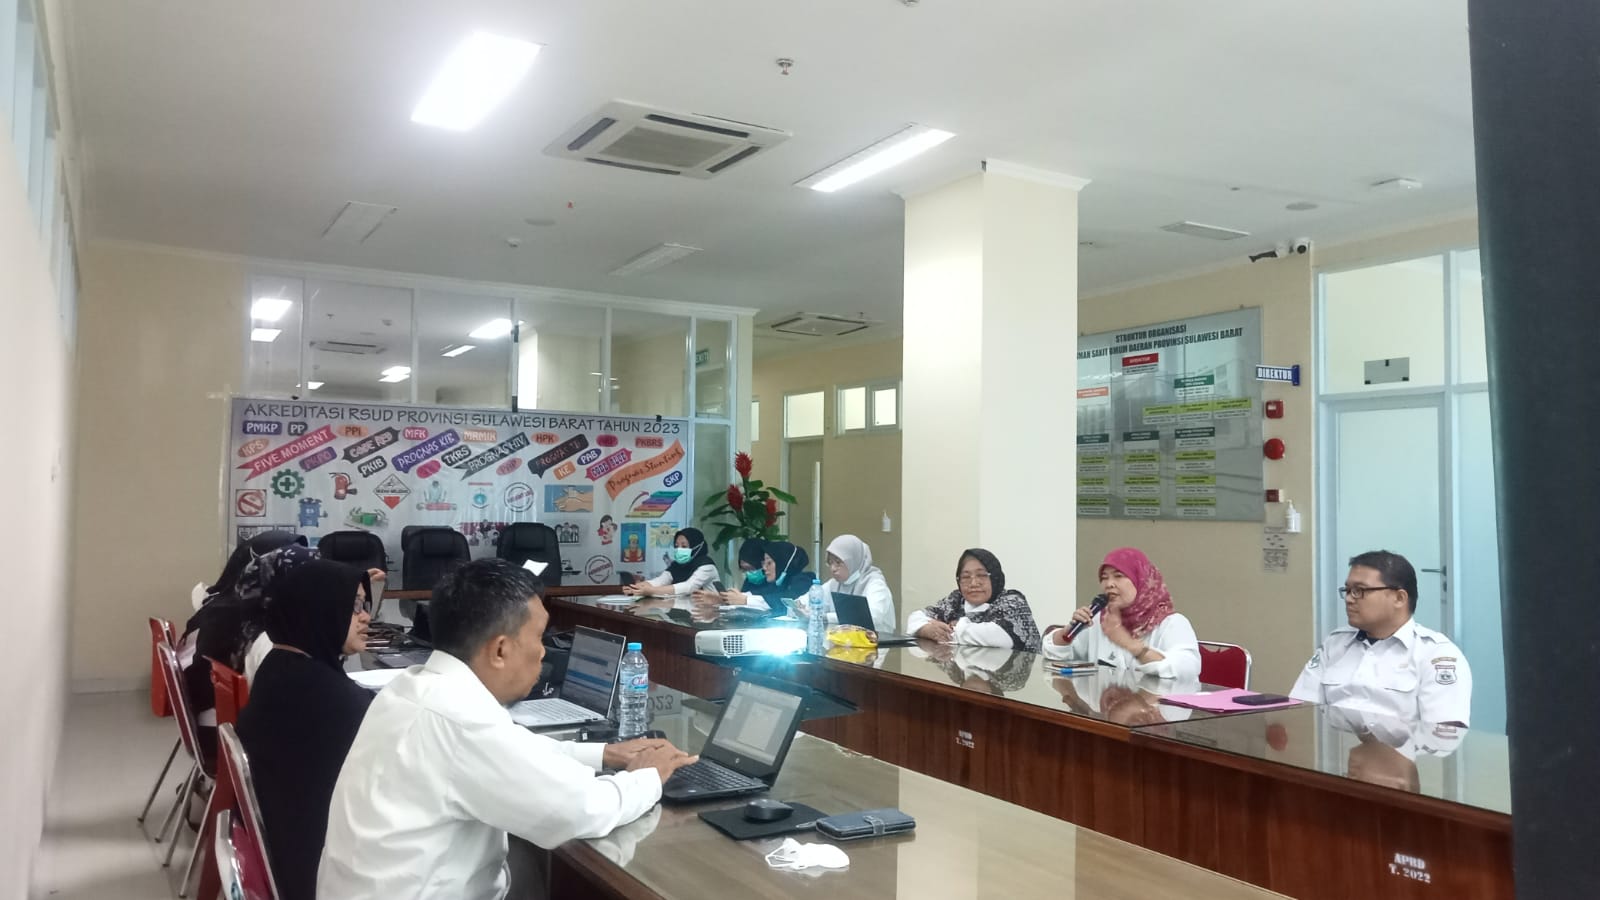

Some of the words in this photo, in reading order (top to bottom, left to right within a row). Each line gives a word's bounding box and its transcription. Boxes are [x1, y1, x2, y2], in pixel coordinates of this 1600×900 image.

[1115, 331, 1147, 343] STRUKTUR
[1148, 324, 1187, 338] ORGANISASI
[1077, 350, 1091, 359] MAH
[1091, 347, 1108, 357] SAKIT
[1109, 345, 1127, 355] UMUM
[1128, 341, 1152, 352] DAERAH
[1153, 337, 1183, 349] PROVINSI
[1184, 331, 1219, 344] SULAWESI
[1220, 327, 1243, 339] BARAT
[1258, 367, 1292, 380] DIREKTUR
[243, 403, 344, 419] AKREDITASI
[349, 408, 393, 421] RSUD
[397, 411, 467, 424] PROVINSI
[471, 413, 545, 428] SULAWESI
[549, 418, 595, 430] BARAT
[597, 420, 640, 432] TAHUN
[643, 422, 680, 434] 2023
[246, 422, 278, 433] PMKP
[290, 424, 305, 433] PP
[345, 426, 361, 436] PPI
[404, 428, 426, 438] MFK
[463, 431, 496, 441] MRMIK
[536, 434, 555, 442] HPK
[242, 440, 264, 457] KPS
[254, 453, 281, 471] FIVE
[280, 429, 329, 458] MOMENT
[397, 441, 439, 468] PROGNAS
[444, 447, 469, 464] TKRS
[468, 444, 509, 471] PROGNAS
[509, 434, 526, 451] HIV
[581, 450, 598, 464] PAB
[558, 464, 570, 477] KE
[665, 472, 680, 486] SKP
